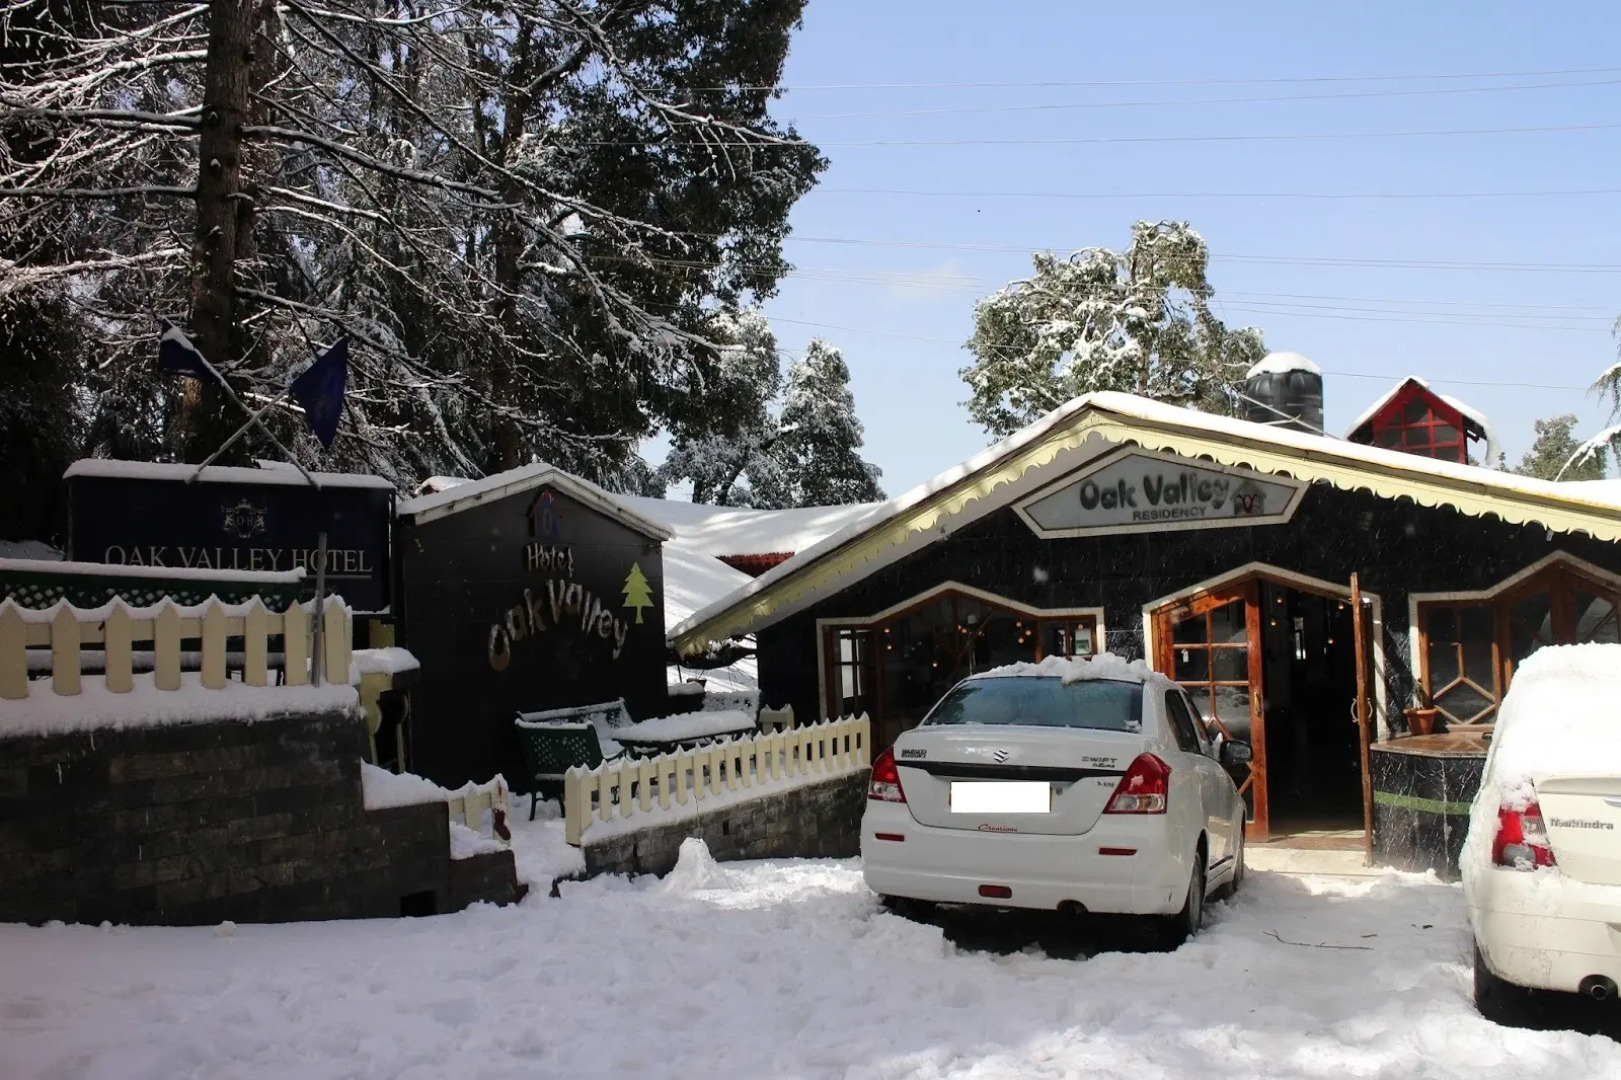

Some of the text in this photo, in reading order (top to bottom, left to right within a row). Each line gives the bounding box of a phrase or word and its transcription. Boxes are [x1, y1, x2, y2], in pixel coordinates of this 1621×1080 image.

[1080, 472, 1230, 510] Oak Valley
[1133, 506, 1207, 521] RESIDENCY
[105, 545, 373, 571] OAK VALLEY HOTEL
[527, 542, 574, 578] Hotel
[547, 578, 628, 661] Valley
